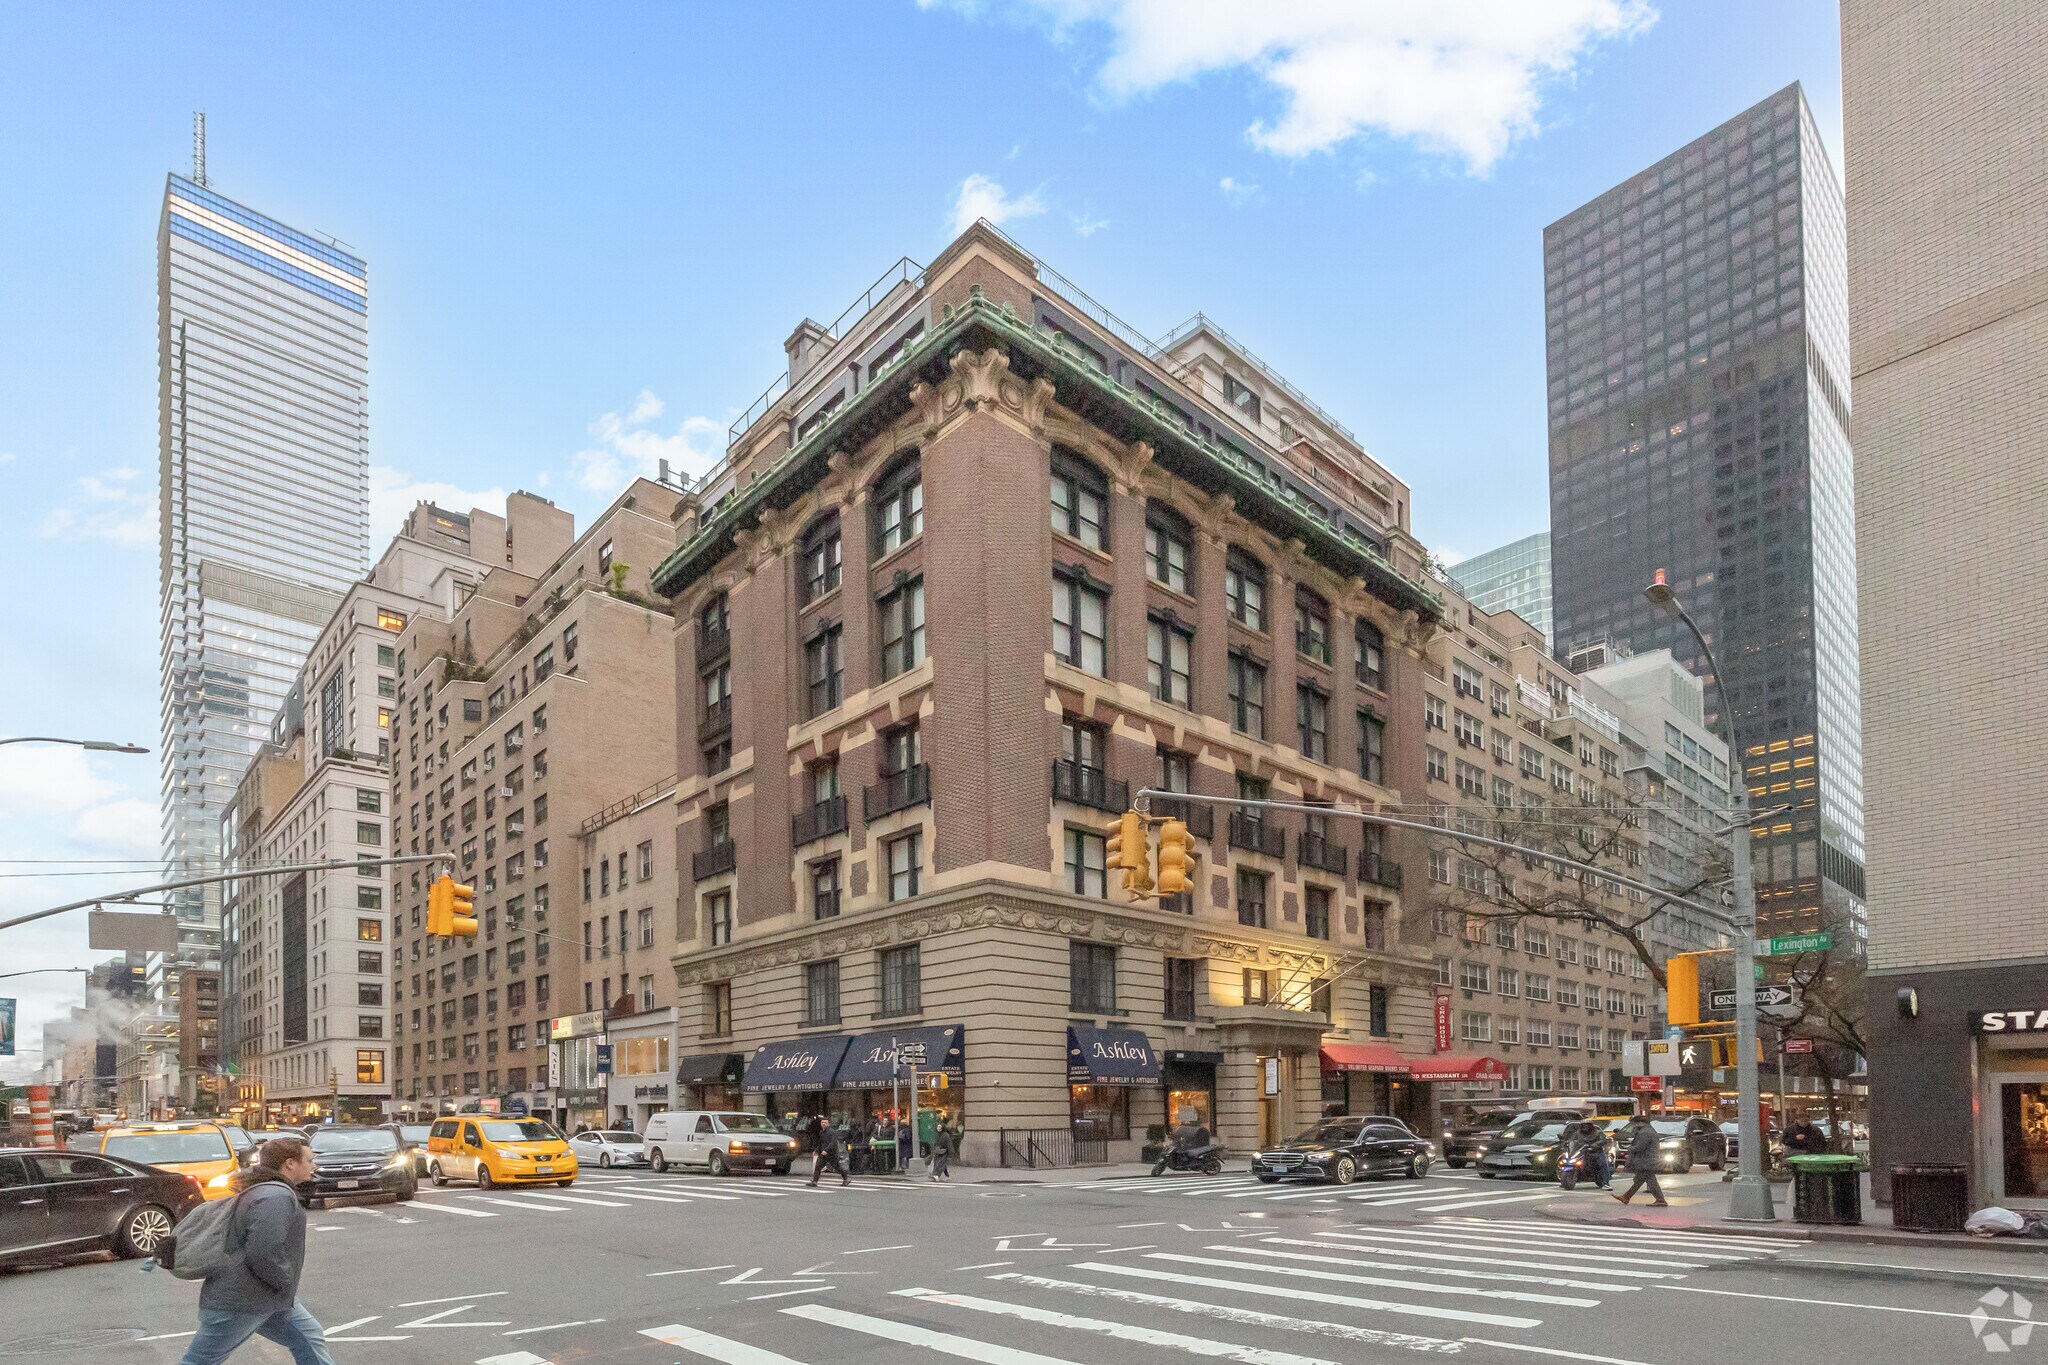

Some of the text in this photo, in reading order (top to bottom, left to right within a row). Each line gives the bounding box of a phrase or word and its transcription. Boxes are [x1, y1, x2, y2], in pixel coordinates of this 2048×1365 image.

[1773, 938, 1818, 951] Lexington
[1755, 991, 1780, 1001] WAY
[1982, 1010, 2048, 1031] STA
[1093, 1041, 1147, 1066] Ashley
[767, 1051, 819, 1073] Ashley
[793, 1082, 823, 1090] ANTIQUES
[859, 1080, 887, 1088] JEWELRY
